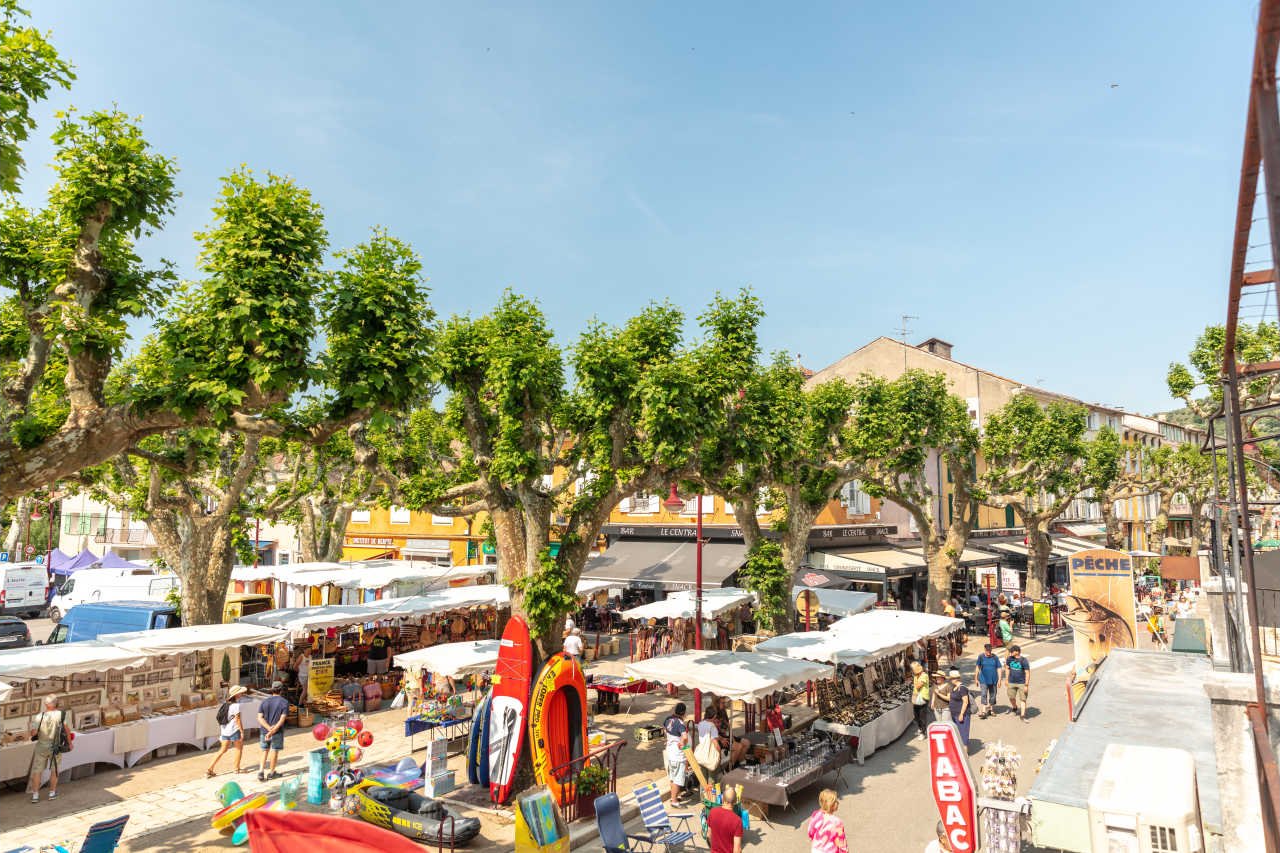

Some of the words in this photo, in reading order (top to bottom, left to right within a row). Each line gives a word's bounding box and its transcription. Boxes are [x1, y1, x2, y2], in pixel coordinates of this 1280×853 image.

[660, 528, 669, 536] LE
[669, 528, 697, 537] CENTRA
[842, 529, 848, 537] LE
[1071, 556, 1131, 571] PÊCHE
[930, 733, 970, 850] TABAC
